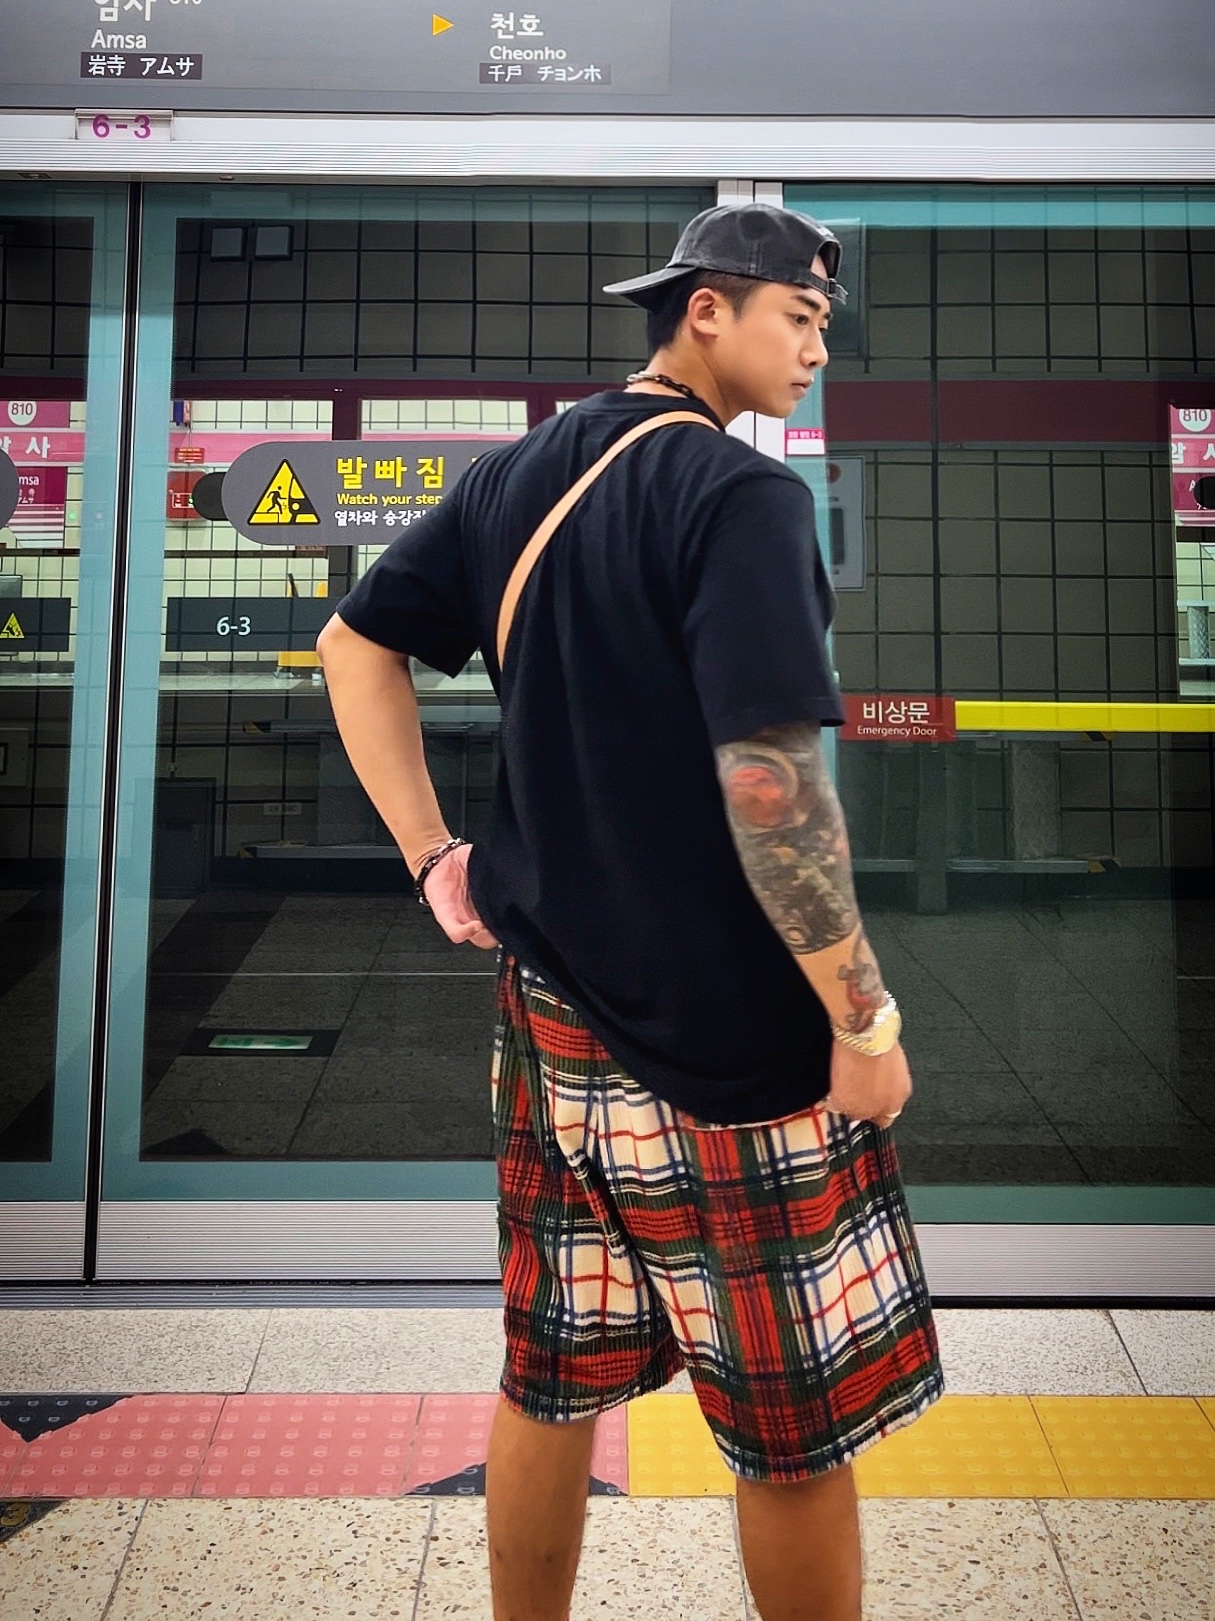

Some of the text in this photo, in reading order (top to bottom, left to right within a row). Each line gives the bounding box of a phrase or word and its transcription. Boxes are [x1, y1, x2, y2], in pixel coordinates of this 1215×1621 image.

[490, 12, 544, 39] 천호
[90, 28, 147, 49] Amsa
[489, 45, 567, 60] Cheonho
[88, 54, 195, 76] 岩寺 アムサ
[537, 64, 602, 82] チョンホ
[92, 113, 151, 138] 6-3
[11, 403, 33, 415] 810
[1183, 409, 1207, 421] 810
[337, 493, 378, 505] Watch
[381, 495, 413, 507] your
[334, 509, 379, 527] 열차와
[216, 616, 251, 636] 6-3
[862, 701, 930, 724] 비상문
[857, 725, 938, 737] Emergency Door
